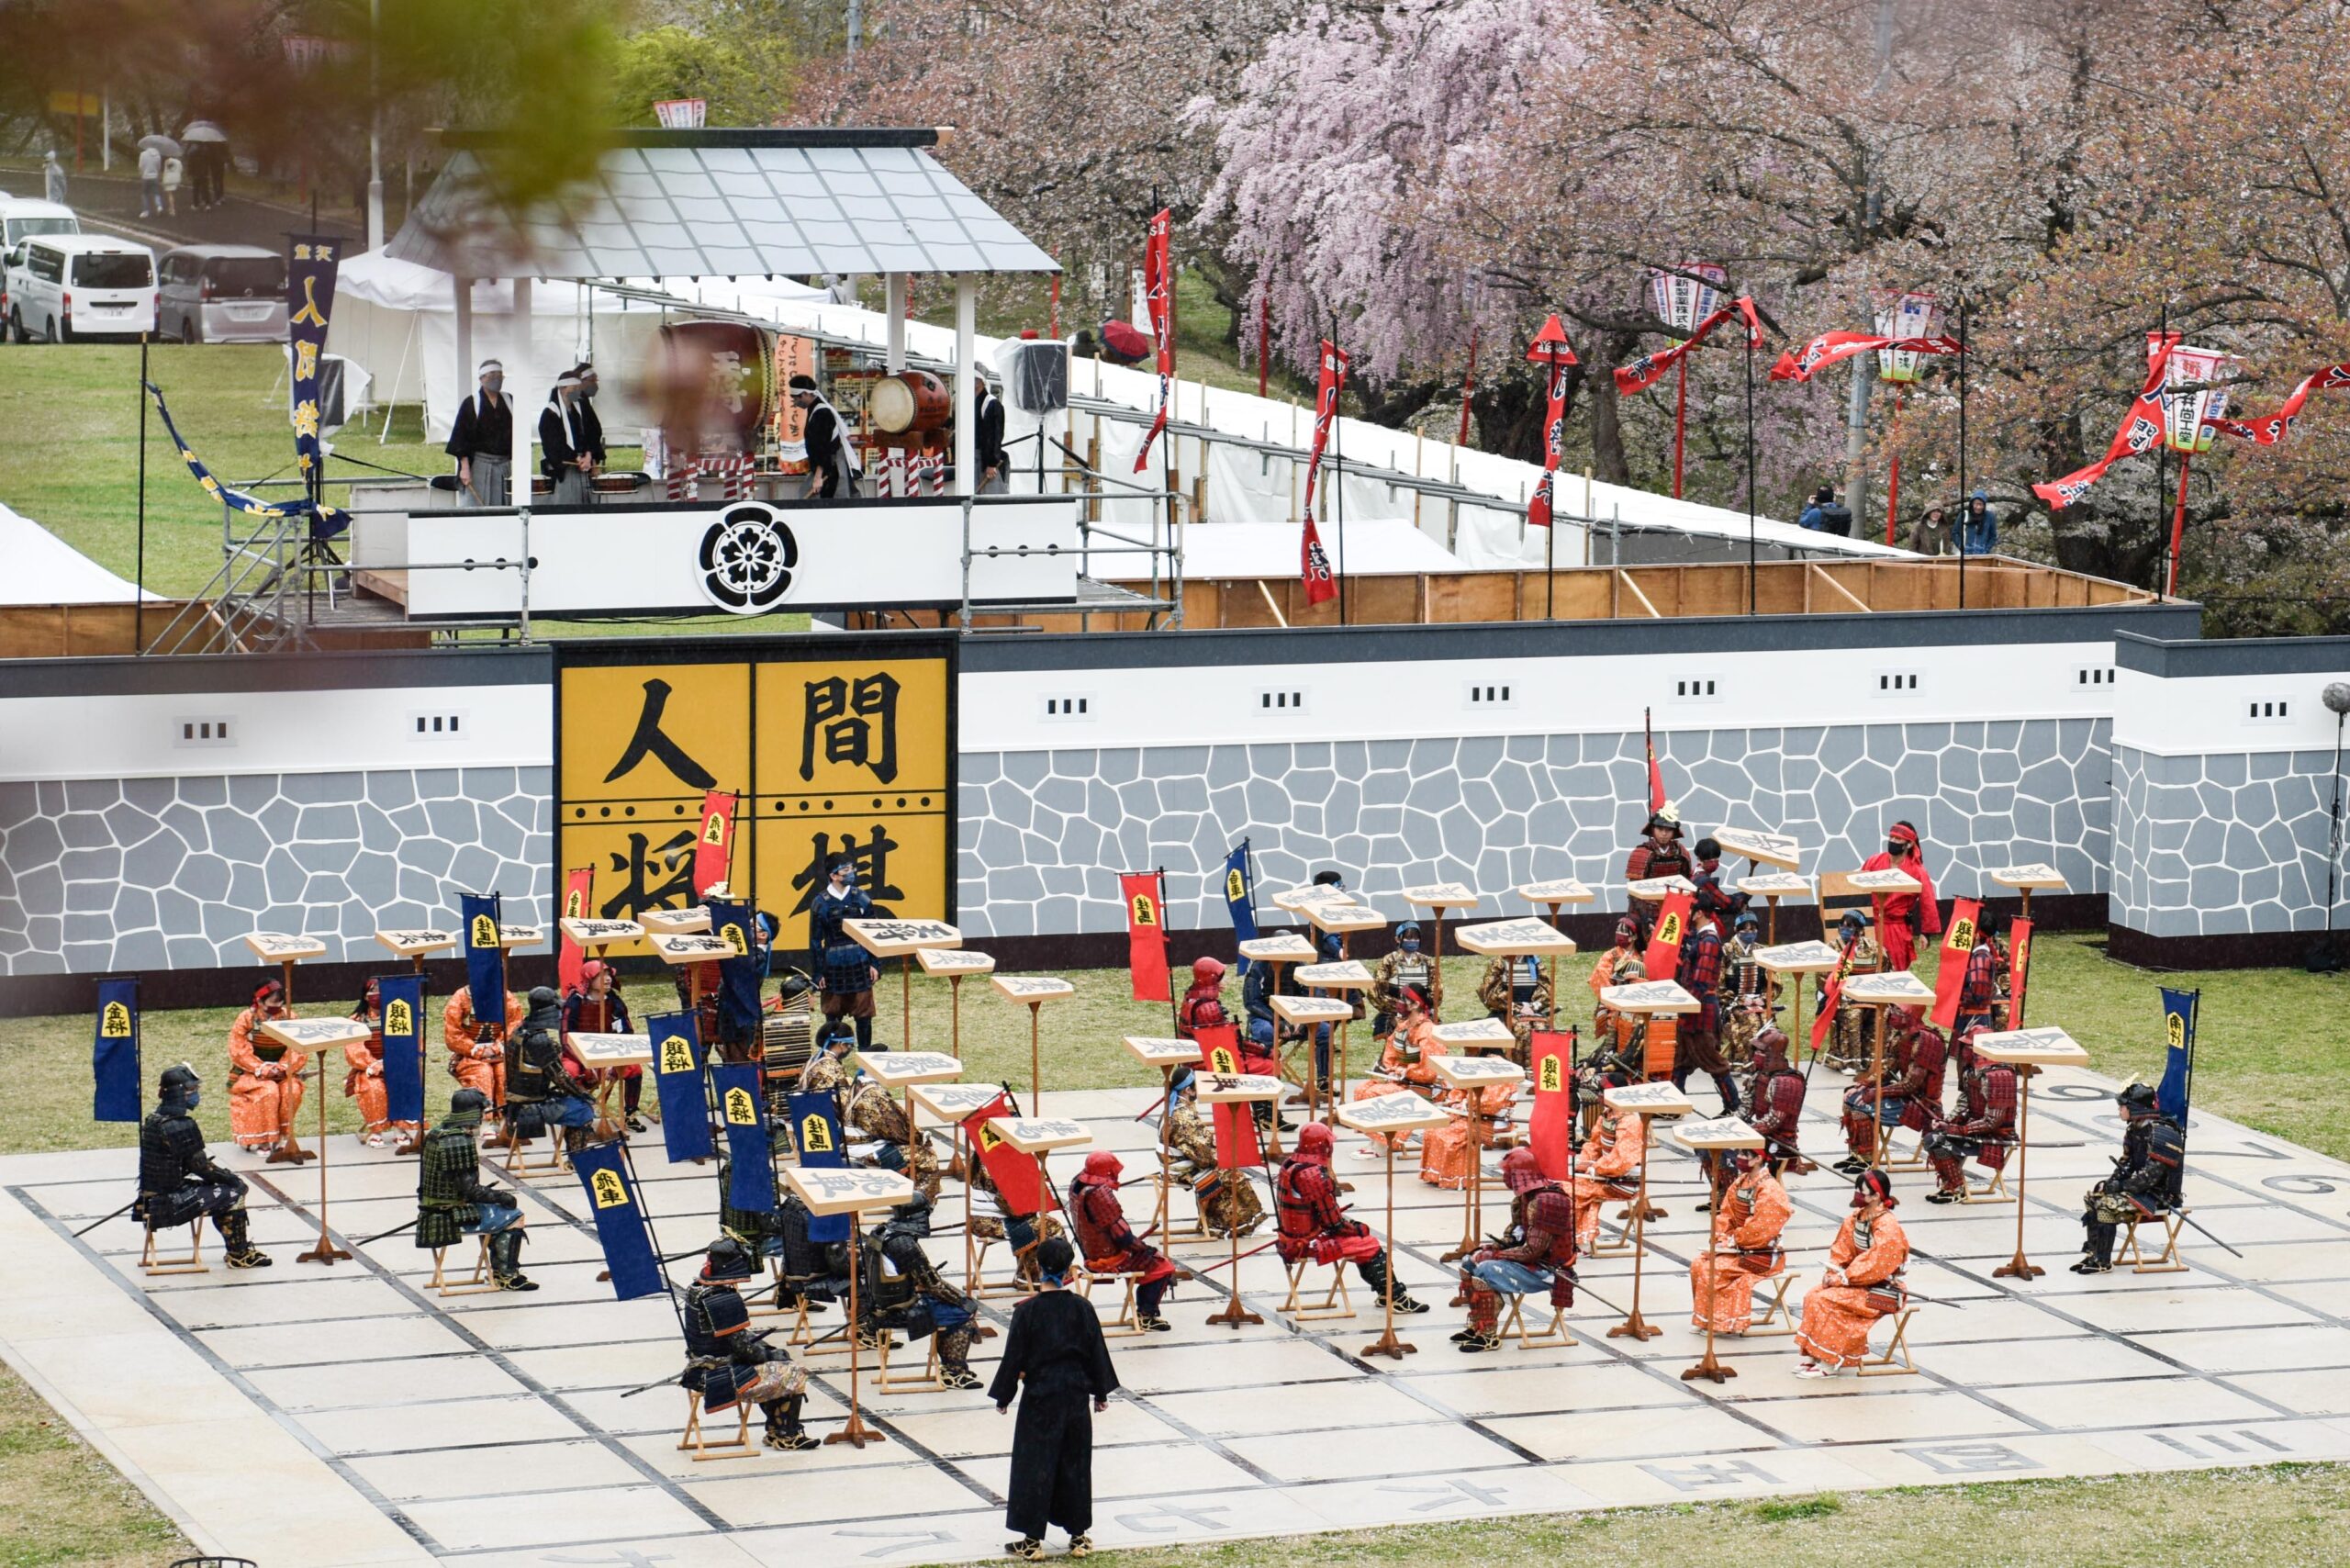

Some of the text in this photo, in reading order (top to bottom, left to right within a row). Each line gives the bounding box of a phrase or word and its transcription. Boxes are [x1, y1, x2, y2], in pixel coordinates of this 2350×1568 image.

[603, 672, 901, 789] 人間
[500, 926, 535, 938] 歩
[572, 921, 639, 936] 香車
[396, 931, 447, 946] 歩兵
[665, 937, 729, 952] 桂馬
[1449, 1059, 1516, 1075] 桂馬
[1202, 1074, 1276, 1092] 香車
[1014, 1120, 1081, 1139] 桂馬
[804, 1171, 906, 1196] 飛車
[2145, 1430, 2293, 1458] 三
[1891, 1443, 2045, 1473] 四
[1637, 1461, 1785, 1491] 五
